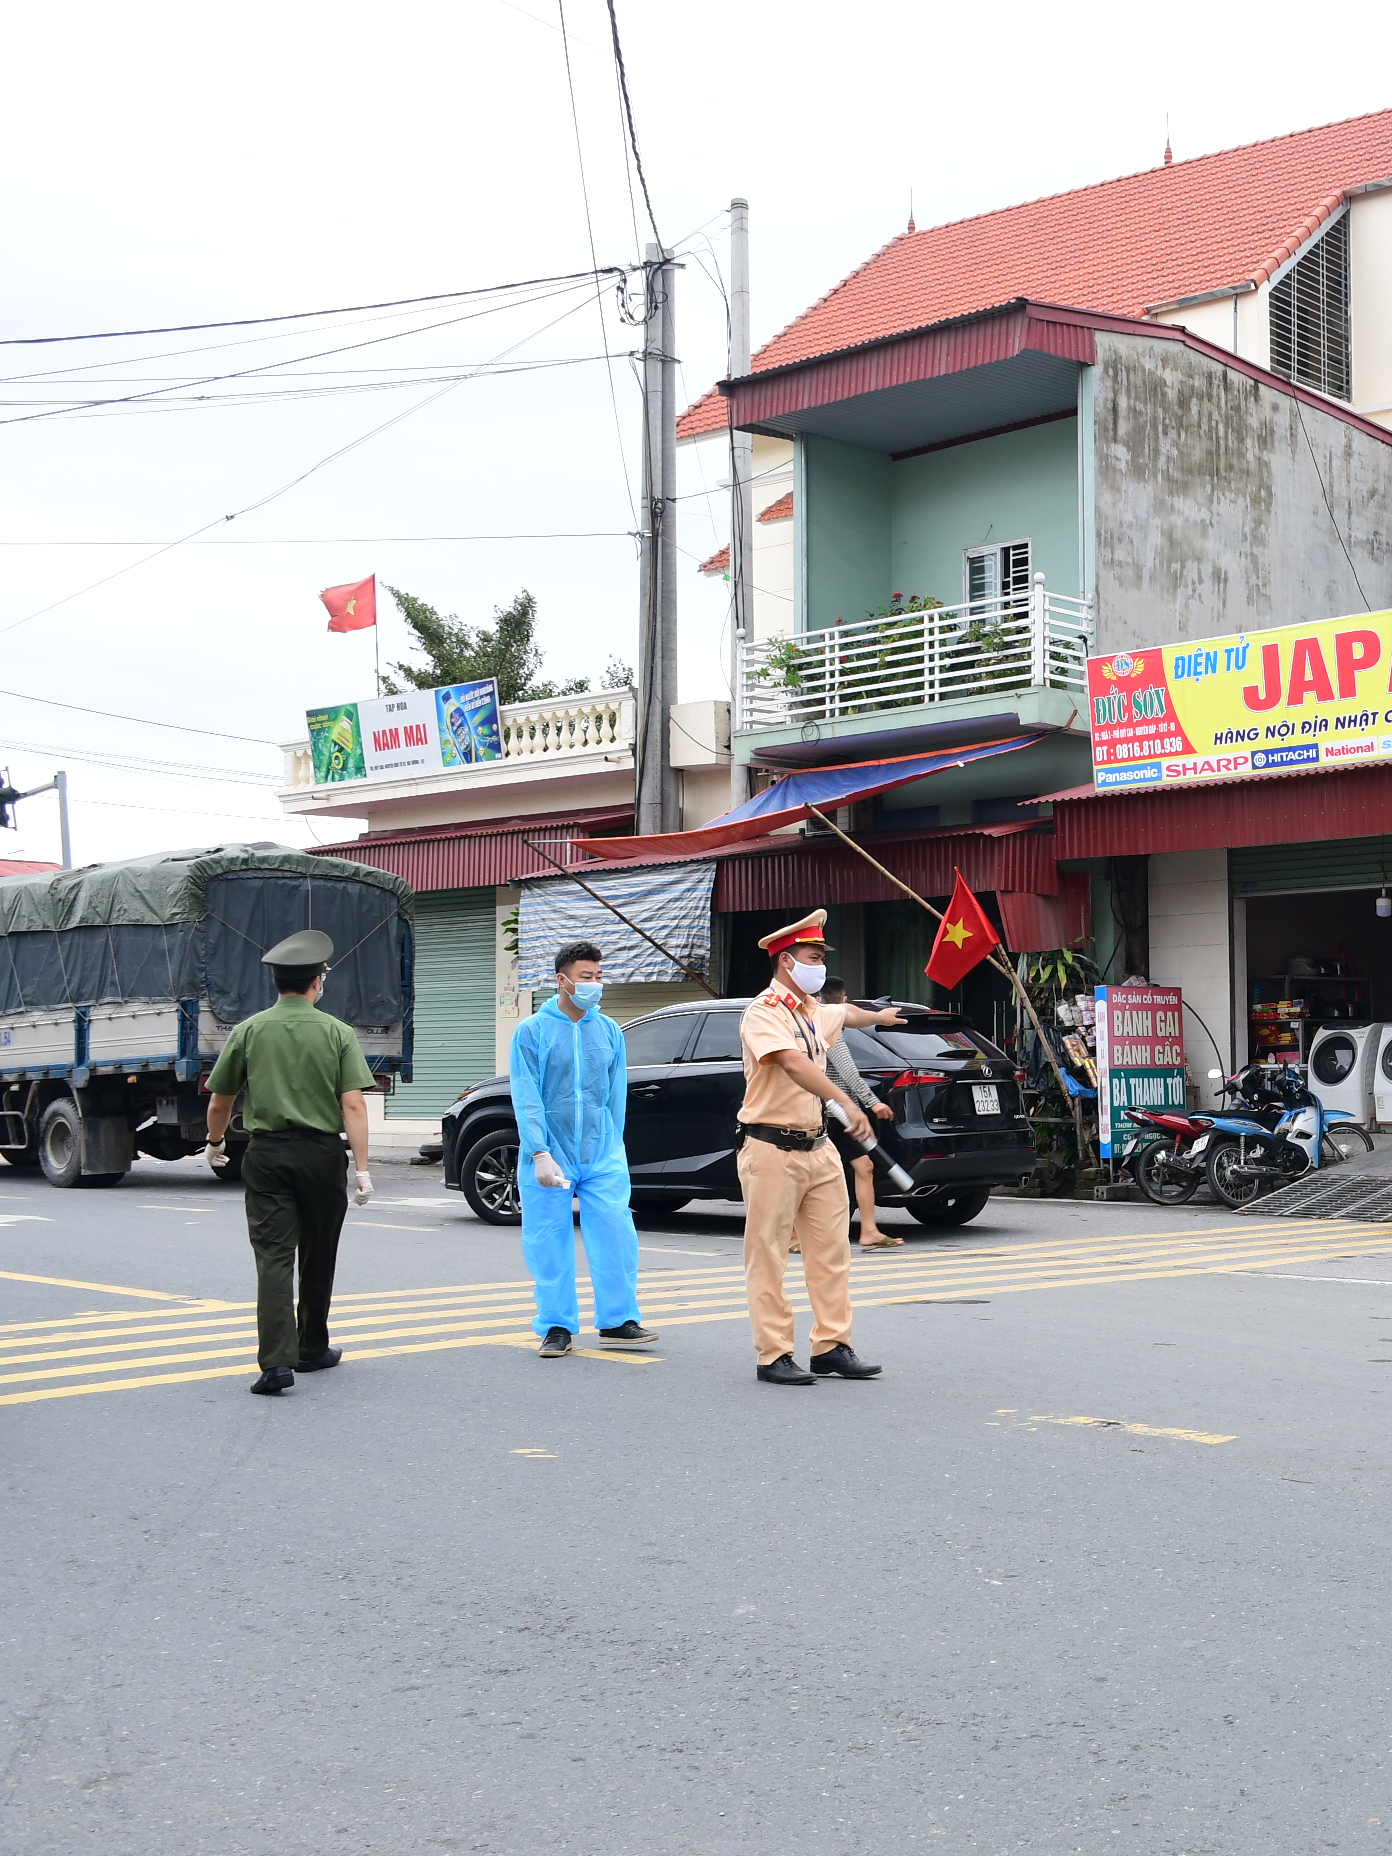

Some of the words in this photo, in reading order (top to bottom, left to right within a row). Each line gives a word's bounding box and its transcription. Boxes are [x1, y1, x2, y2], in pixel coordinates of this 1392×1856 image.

[1174, 648, 1217, 681] ĐIỆN
[1224, 635, 1249, 671] TỬ
[1094, 685, 1128, 725] ĐỨC
[373, 727, 401, 752] NAM
[404, 723, 428, 747] MAI
[1213, 726, 1259, 746] HÀNG
[1265, 719, 1295, 739] NỘI
[1300, 716, 1328, 737] ĐỊA
[1334, 710, 1378, 732] NHẬT
[1116, 736, 1183, 760] 0816.810.936
[1267, 748, 1317, 764] HITACHI
[1325, 741, 1374, 757] National
[1097, 766, 1158, 783] Panasonic
[1165, 755, 1249, 778] SHARP
[1112, 992, 1126, 1006] ĐẶC
[1127, 991, 1141, 1004] SẢN
[1143, 989, 1152, 1004] CỔ
[1113, 1005, 1151, 1037] BÁNH
[1156, 1011, 1179, 1037] GAI
[1113, 1041, 1151, 1066] BÁNH
[1154, 1039, 1181, 1066] GẤC
[1113, 1072, 1128, 1107] BÀ
[1130, 1078, 1165, 1106] THANH
[1166, 1069, 1184, 1105] TỚI
